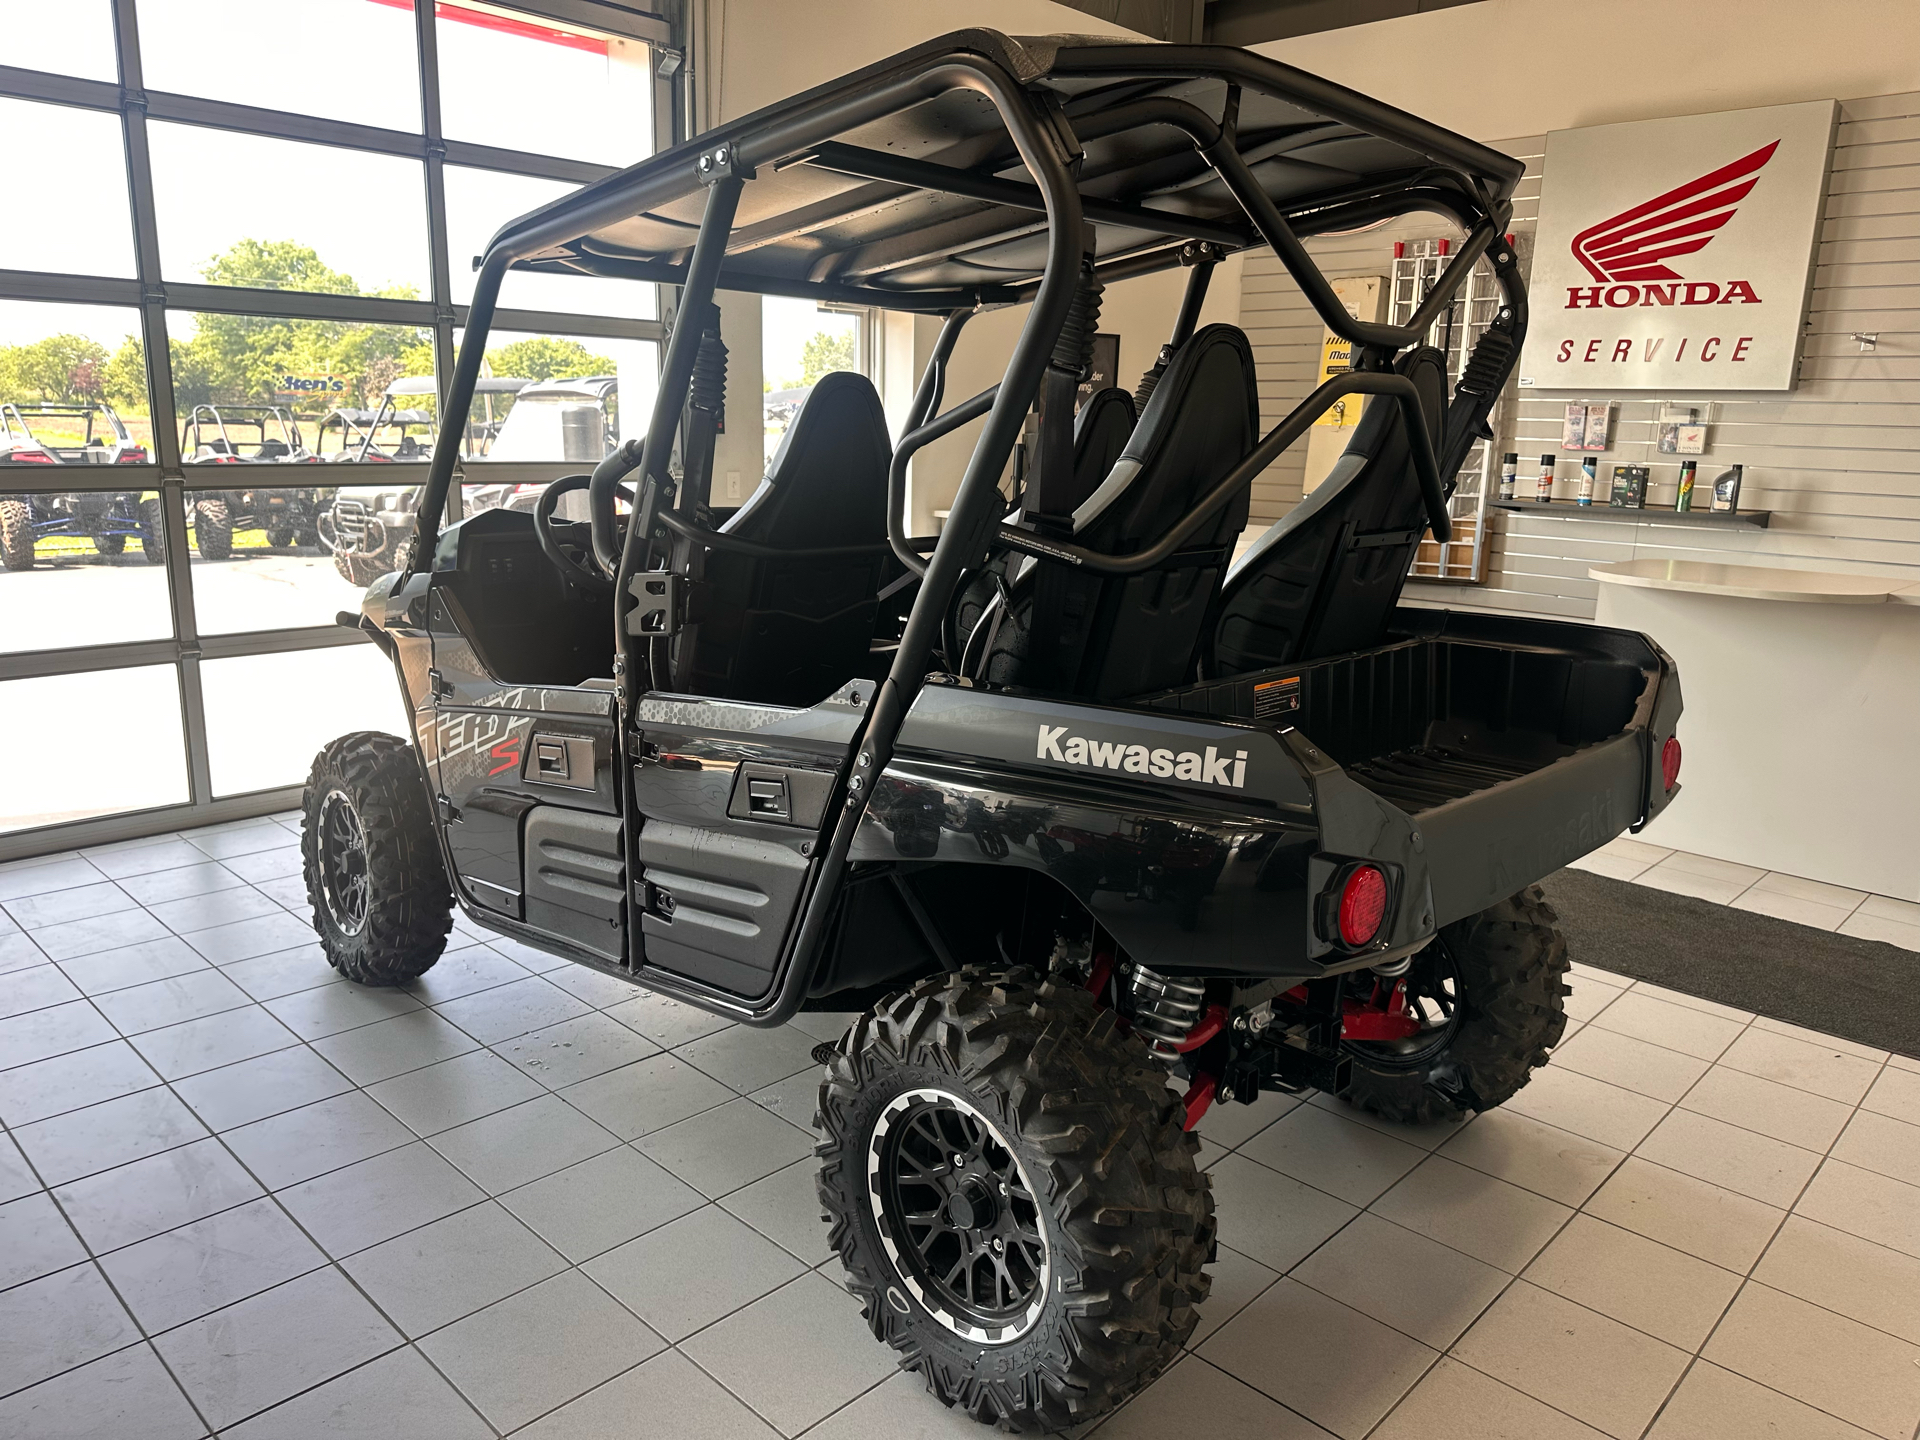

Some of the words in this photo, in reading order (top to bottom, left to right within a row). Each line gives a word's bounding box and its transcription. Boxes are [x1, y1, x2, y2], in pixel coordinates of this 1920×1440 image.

[1564, 280, 1762, 309] HONDA
[1557, 337, 1753, 363] SERVICE
[488, 738, 519, 776] S
[1037, 724, 1249, 788] Kawasaki
